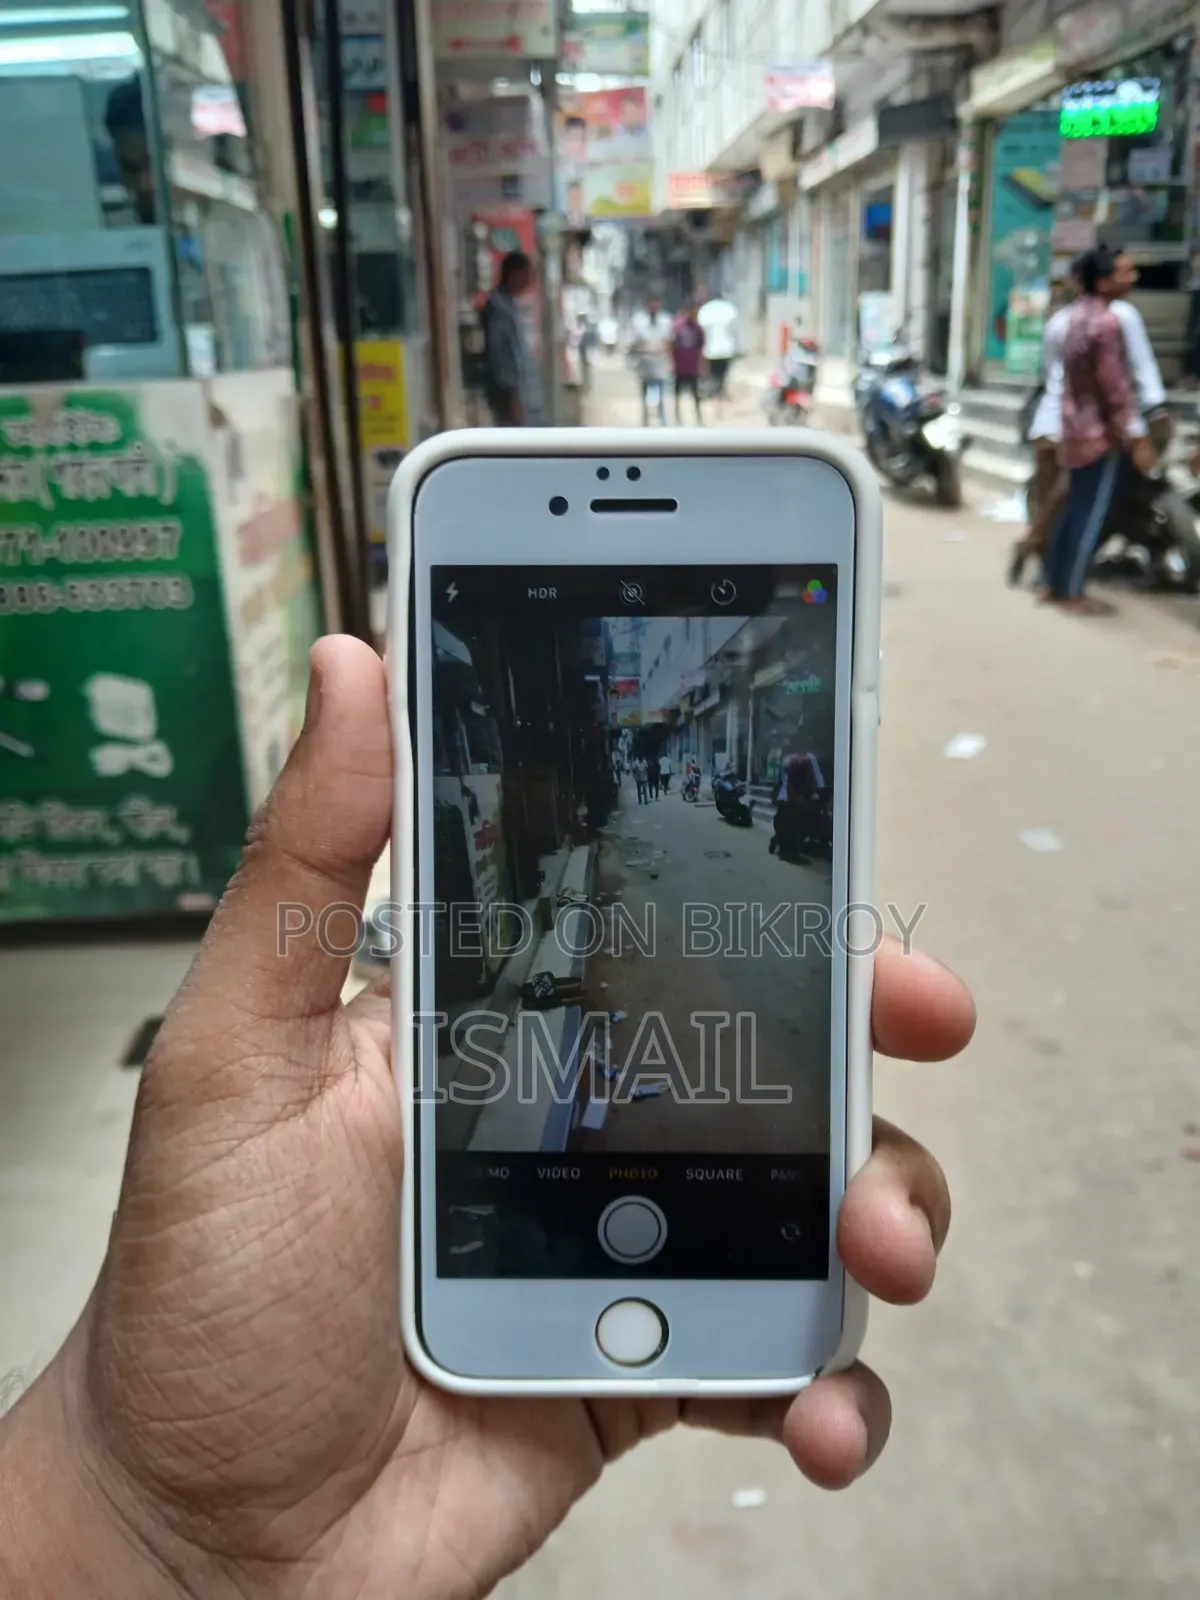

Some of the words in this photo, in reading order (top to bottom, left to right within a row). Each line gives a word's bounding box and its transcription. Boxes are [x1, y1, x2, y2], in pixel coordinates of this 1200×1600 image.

[526, 586, 558, 600] HDR
[537, 1167, 580, 1180] VIDEO
[609, 1168, 658, 1181] PHOTO
[685, 1167, 744, 1181] SQUARE
